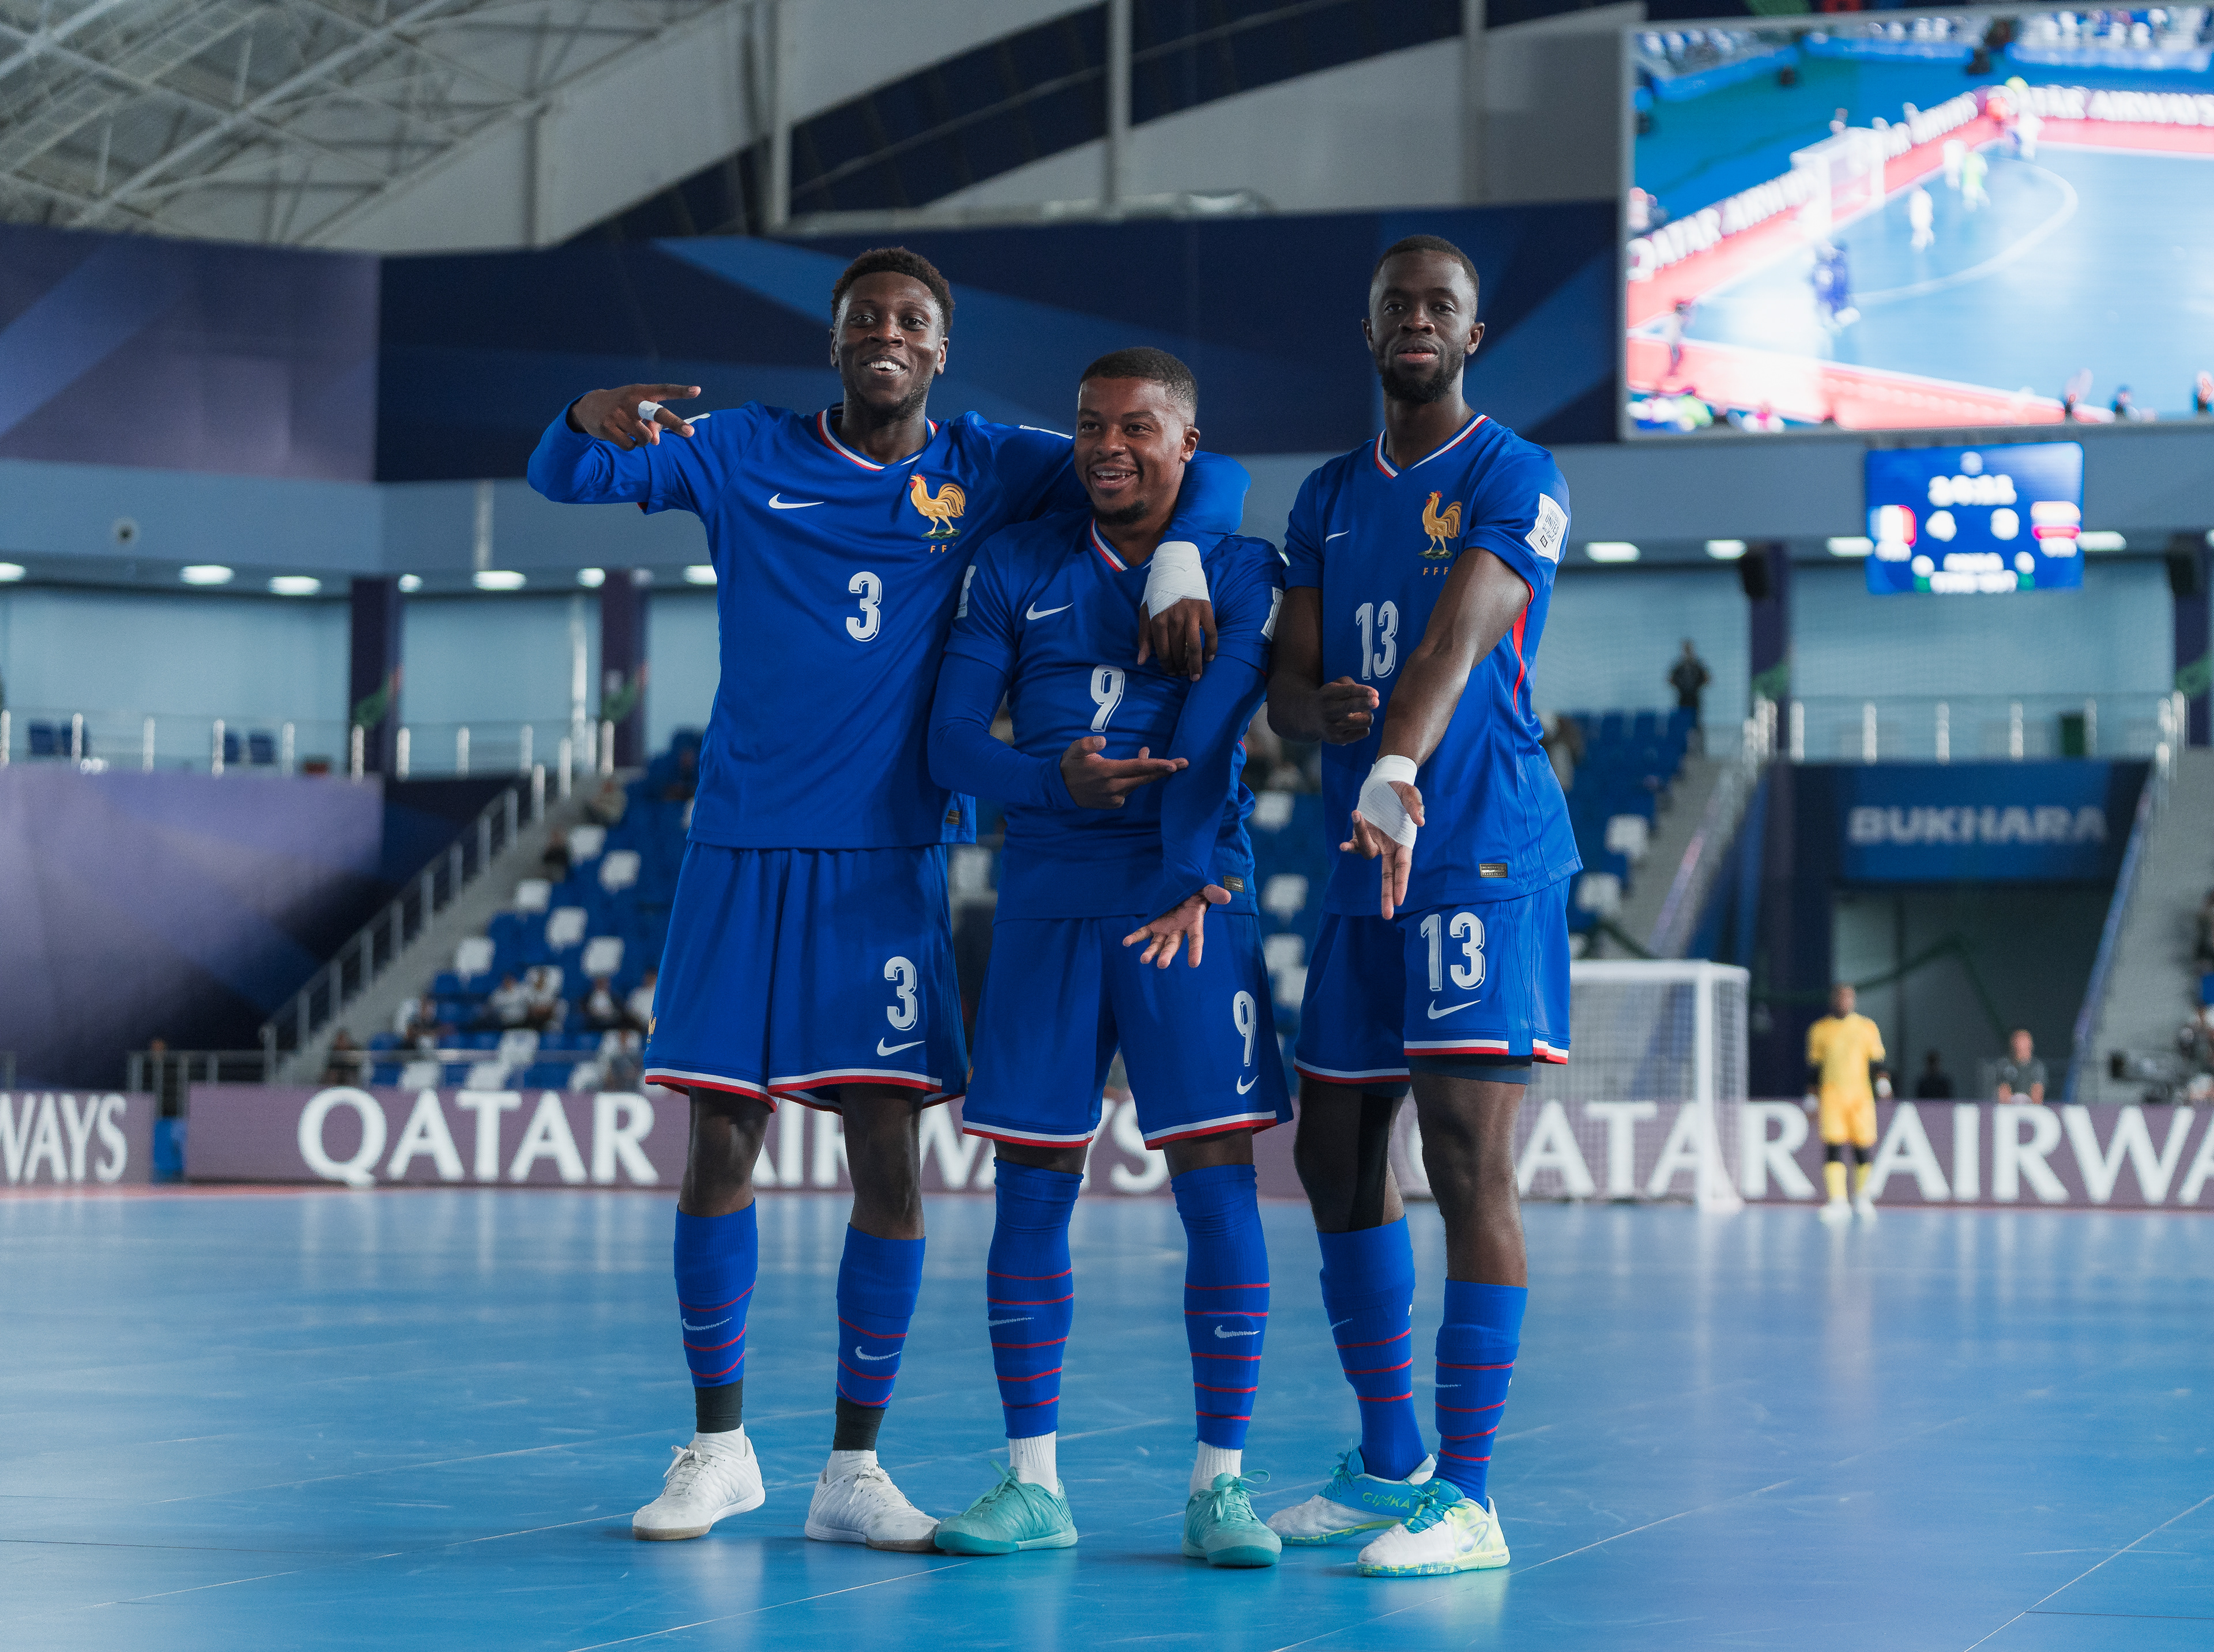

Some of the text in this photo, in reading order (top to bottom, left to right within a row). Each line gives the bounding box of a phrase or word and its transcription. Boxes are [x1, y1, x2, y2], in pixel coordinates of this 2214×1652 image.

[1545, 513, 1560, 535] UNITES
[846, 571, 882, 642] 3
[1423, 567, 1448, 575] FFF
[1355, 600, 1399, 680] 13
[1090, 664, 1125, 733] 9
[1848, 806, 2108, 844] BUKHARA
[1420, 912, 1486, 991] 13
[884, 956, 918, 1030] 3
[1233, 990, 1256, 1067] 9
[297, 1086, 659, 1187] QATAR
[1408, 1100, 1817, 1199] ATAR
